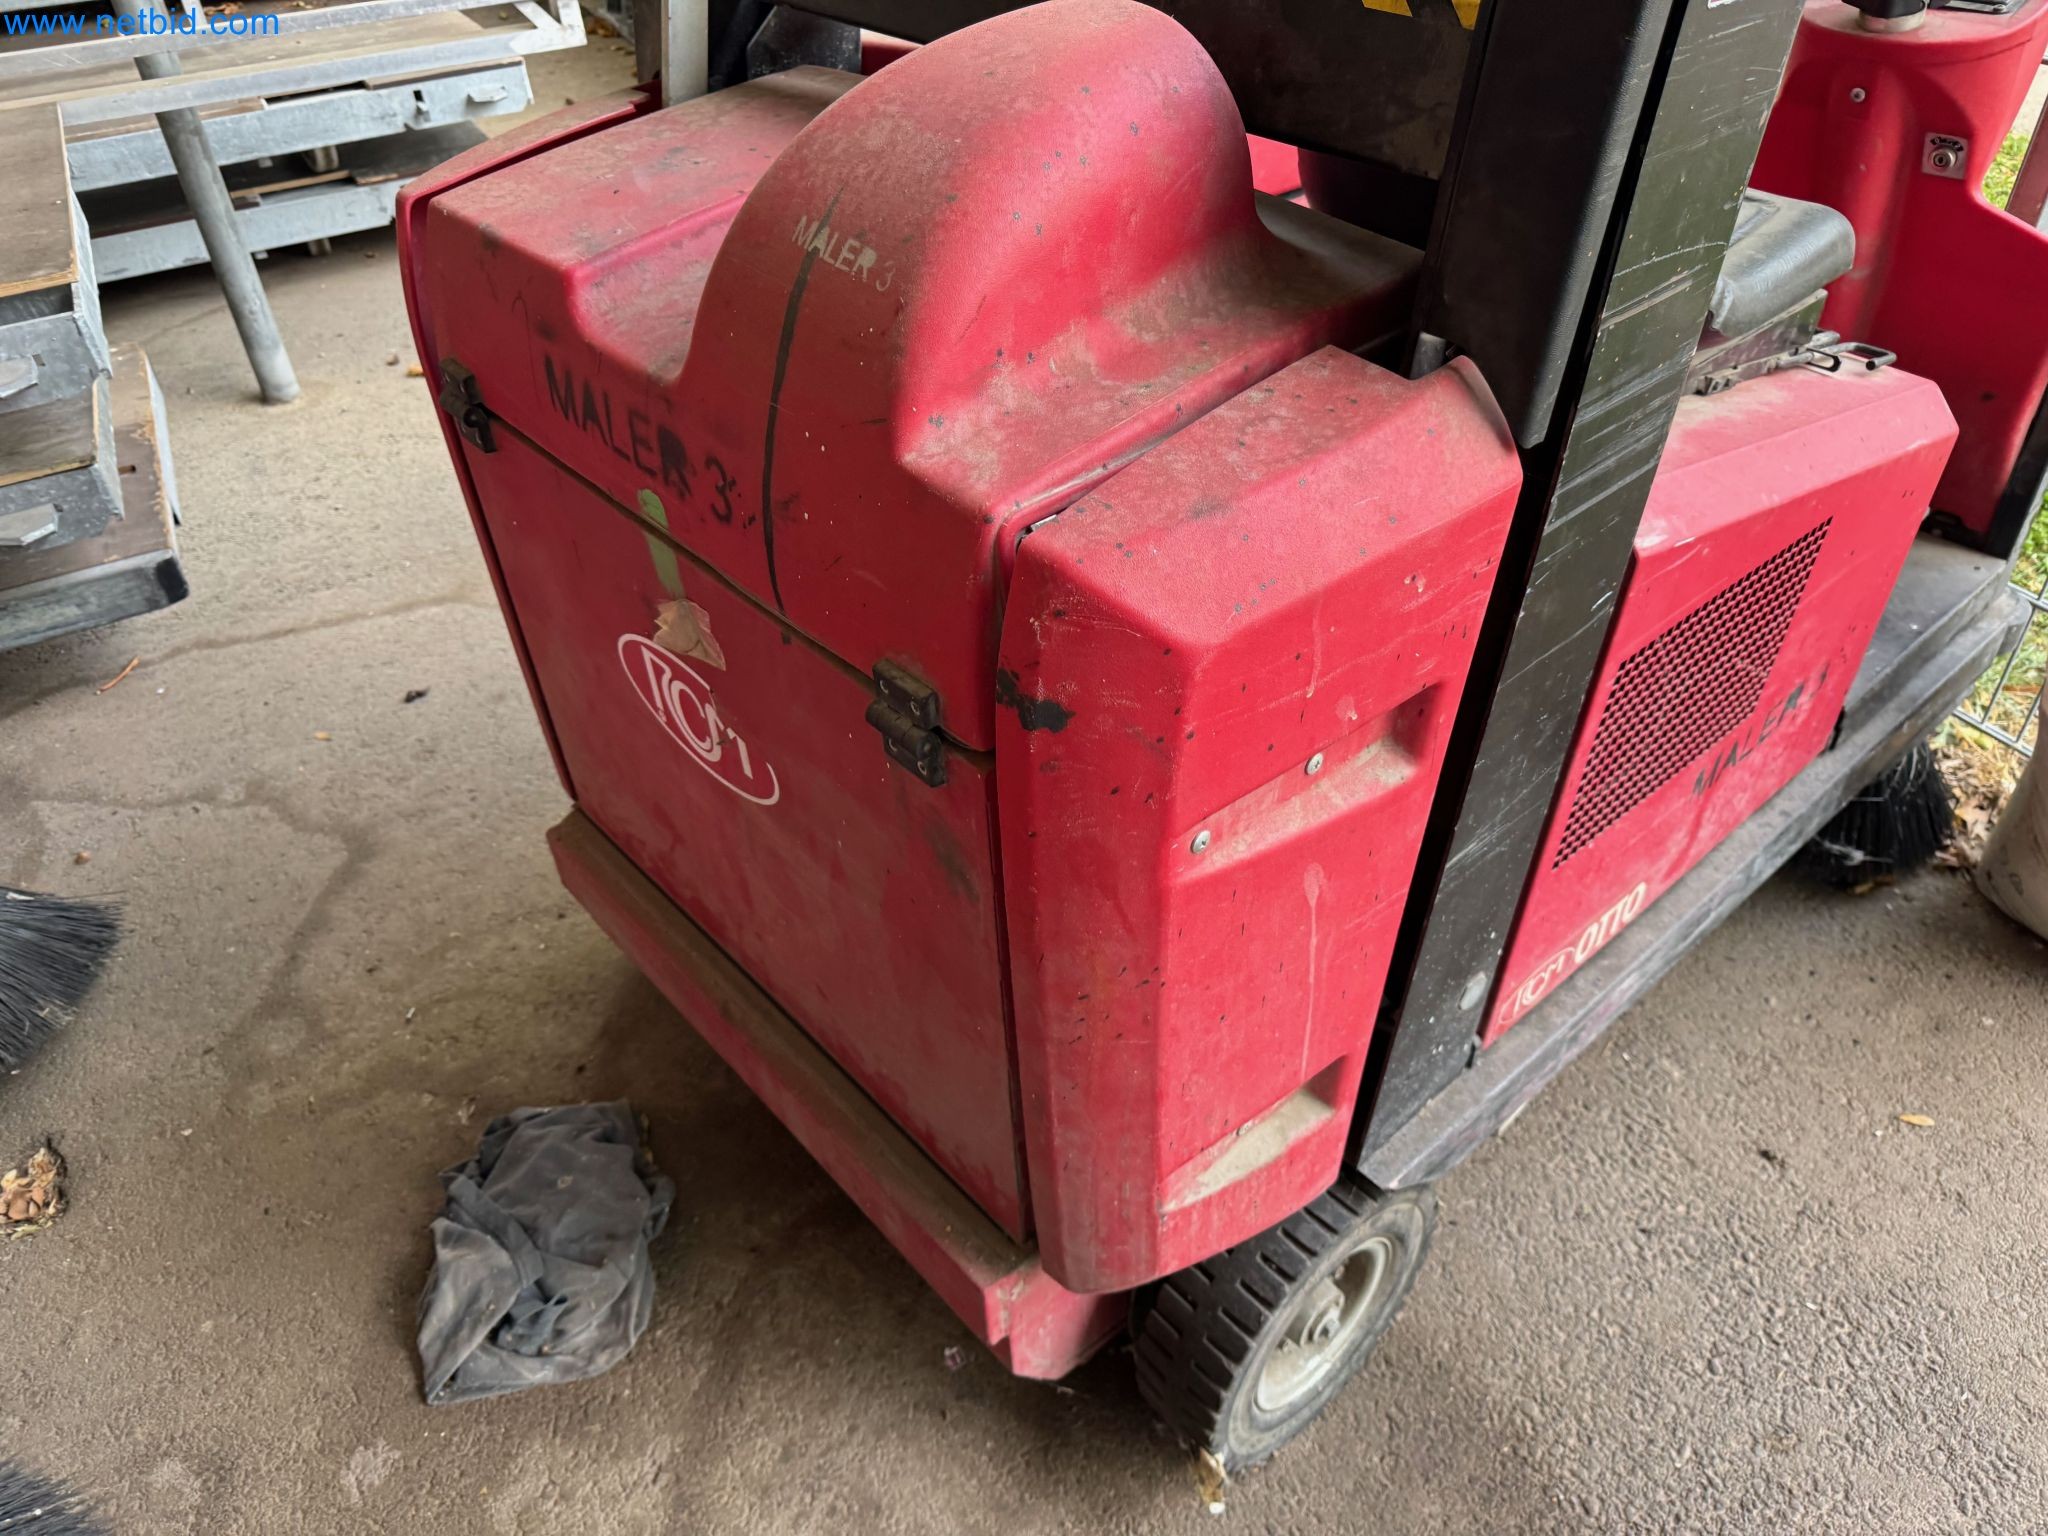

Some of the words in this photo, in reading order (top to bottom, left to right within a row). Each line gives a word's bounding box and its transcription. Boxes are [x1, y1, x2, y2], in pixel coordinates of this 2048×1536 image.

[792, 215, 877, 282] MALER
[876, 261, 896, 291] 3
[544, 355, 693, 500] MALER
[704, 454, 734, 525] 3
[1574, 882, 1647, 964] OTTO
